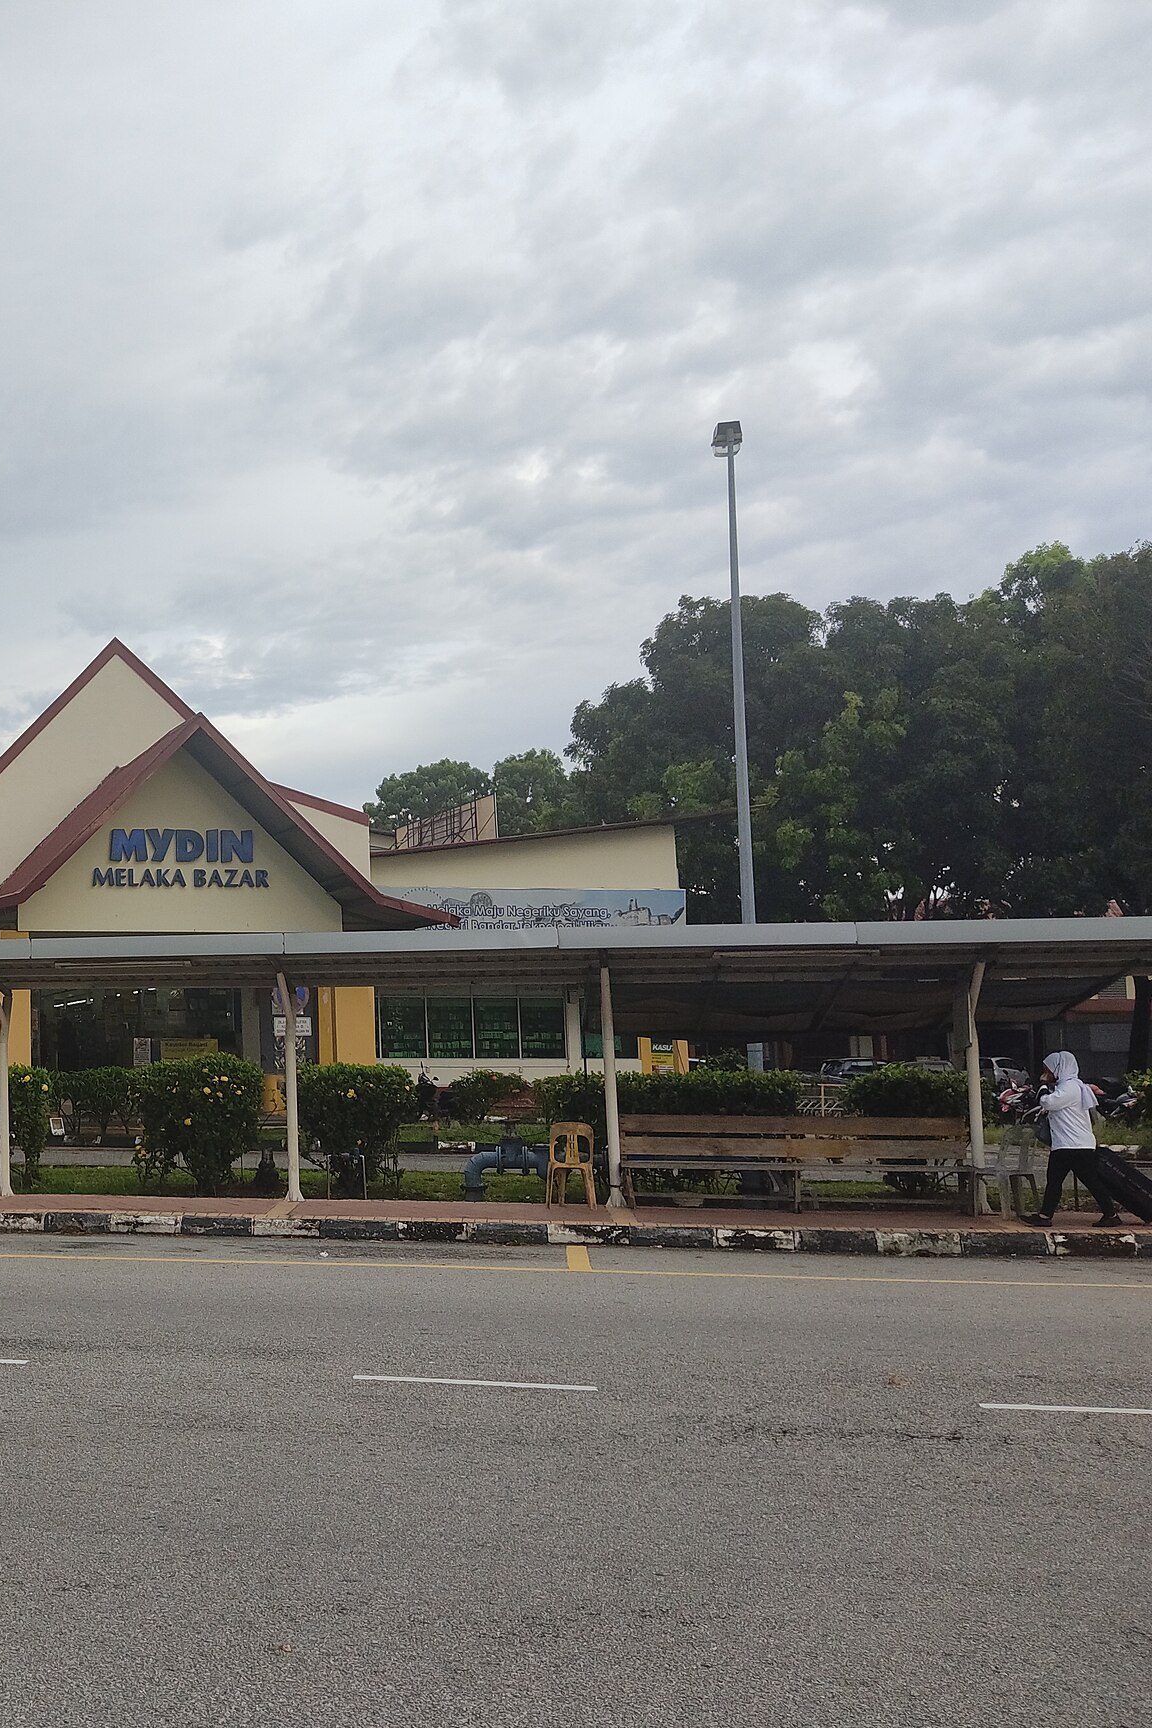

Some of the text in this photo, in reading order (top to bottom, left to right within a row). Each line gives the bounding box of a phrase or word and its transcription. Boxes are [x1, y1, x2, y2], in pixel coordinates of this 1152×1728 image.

[110, 828, 254, 863] MYDIN
[91, 867, 270, 888] MELAKA BAZAR
[474, 905, 505, 919] Maju
[507, 905, 560, 919] Negeriku
[563, 907, 611, 920] Sayang,
[652, 1043, 673, 1051] KASU
